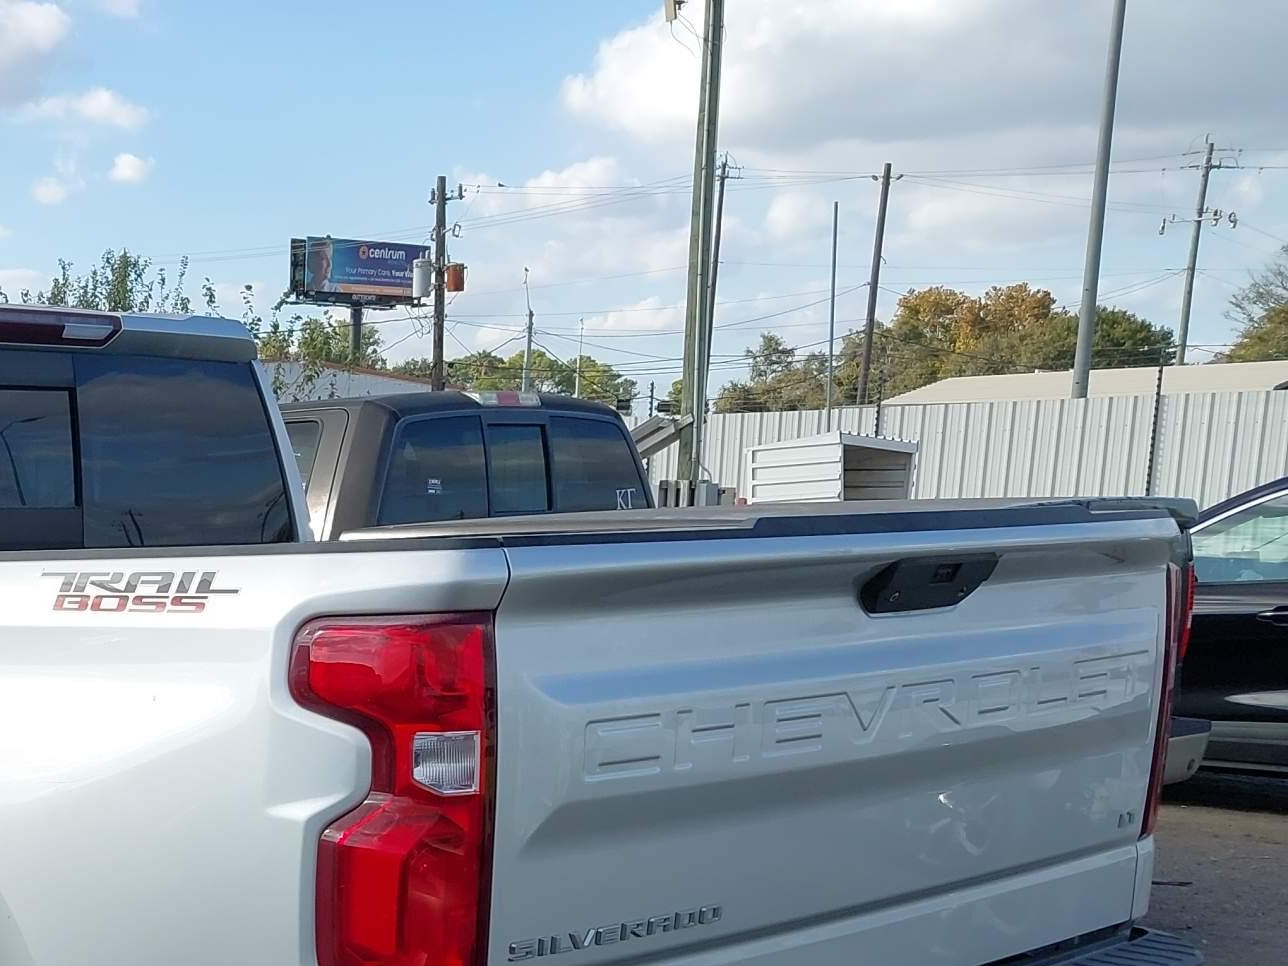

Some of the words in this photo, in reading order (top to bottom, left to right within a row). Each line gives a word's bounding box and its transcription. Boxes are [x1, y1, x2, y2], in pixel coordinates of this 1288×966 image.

[369, 247, 406, 260] centrum
[41, 571, 240, 594] TRAIL
[52, 594, 209, 613] BOSS
[583, 649, 1150, 782] CHEVROLET
[507, 903, 723, 962] SILVERADO
